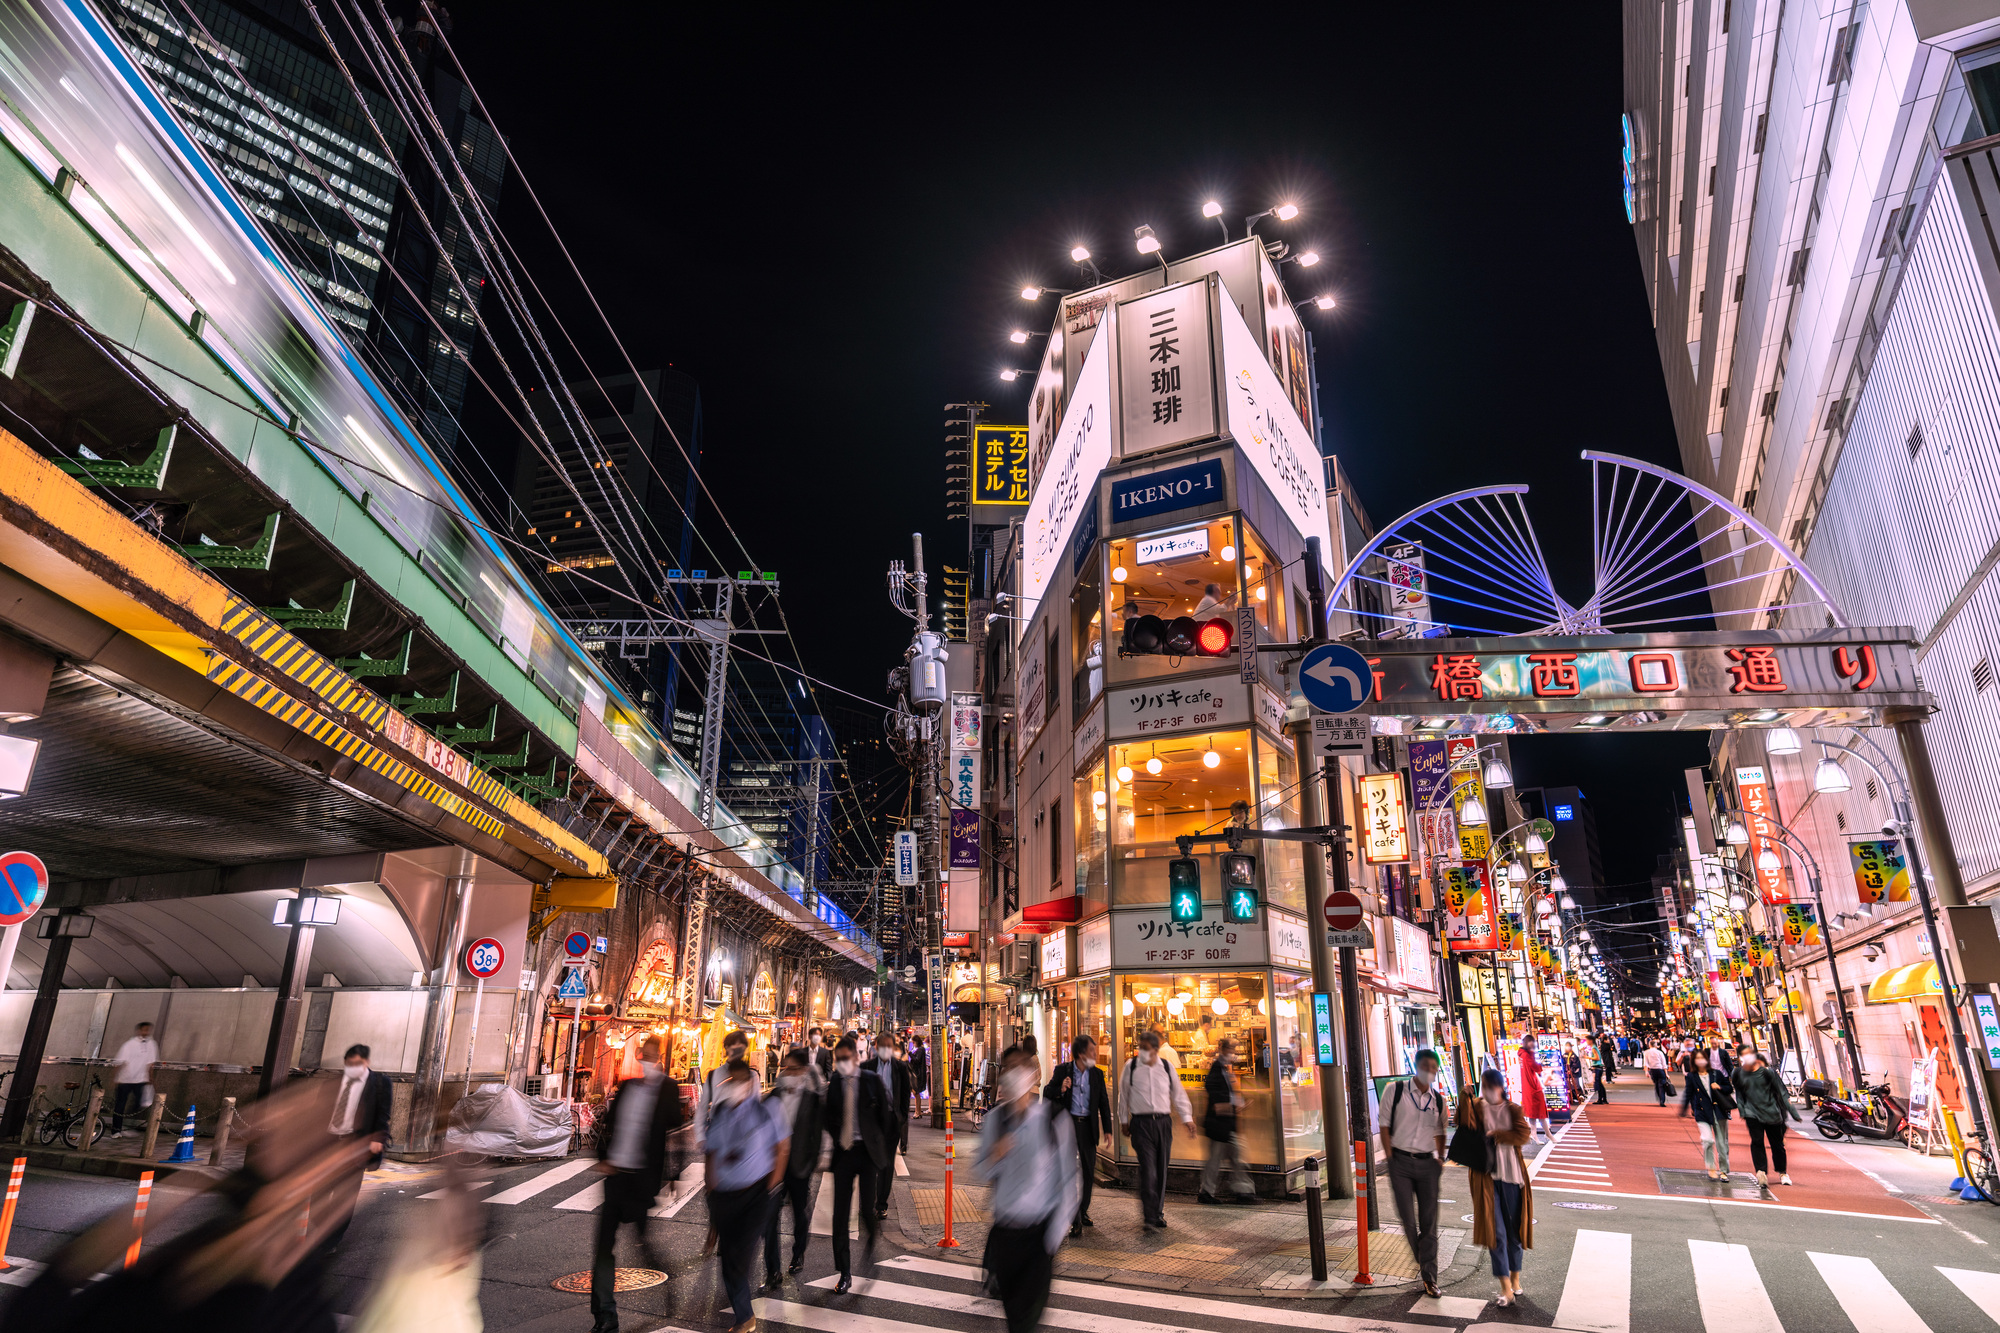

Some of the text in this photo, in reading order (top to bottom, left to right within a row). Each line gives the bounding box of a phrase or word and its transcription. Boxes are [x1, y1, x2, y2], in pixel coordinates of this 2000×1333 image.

[1149, 307, 1182, 426] 三本珈琲
[985, 439, 1005, 491] ホテル
[1009, 431, 1029, 500] カプセル
[1048, 403, 1094, 523] MITSUMOTO
[1266, 408, 1321, 509] MITSUMOTO
[1119, 473, 1214, 509] IKENO-1
[1269, 443, 1309, 517] COFFEE
[1049, 472, 1079, 553] COFFEE
[1142, 540, 1196, 557] ツバキcafe
[1392, 547, 1414, 560] 4F
[1240, 610, 1256, 681] スクランブル式
[957, 695, 976, 704] 4F
[1130, 689, 1212, 713] ツバキcafe
[1193, 712, 1217, 724] 60席
[955, 708, 966, 746] オアシス
[1315, 718, 1366, 729] 自転車を除く
[1316, 729, 1367, 741] 一方通行
[431, 740, 468, 782] 3.8M
[1412, 750, 1444, 773] Enjoy
[958, 757, 974, 807] 個人輸入代行
[952, 821, 979, 839] Enjoy
[1371, 788, 1391, 835] ツバキ
[1374, 836, 1396, 848] cafe
[1748, 787, 1783, 902] パチンコ&ロット
[901, 850, 911, 875] セキネ
[1859, 845, 1885, 901] 西口通り
[1448, 871, 1465, 916] 西口通り
[1138, 920, 1225, 940] ツバキcafe
[1327, 935, 1365, 945] 自転車を除く
[1205, 948, 1231, 960] 60席
[932, 981, 942, 1012] セキネ
[1317, 1003, 1331, 1055] 共栄会
[1979, 1004, 2000, 1059] 共栄会
